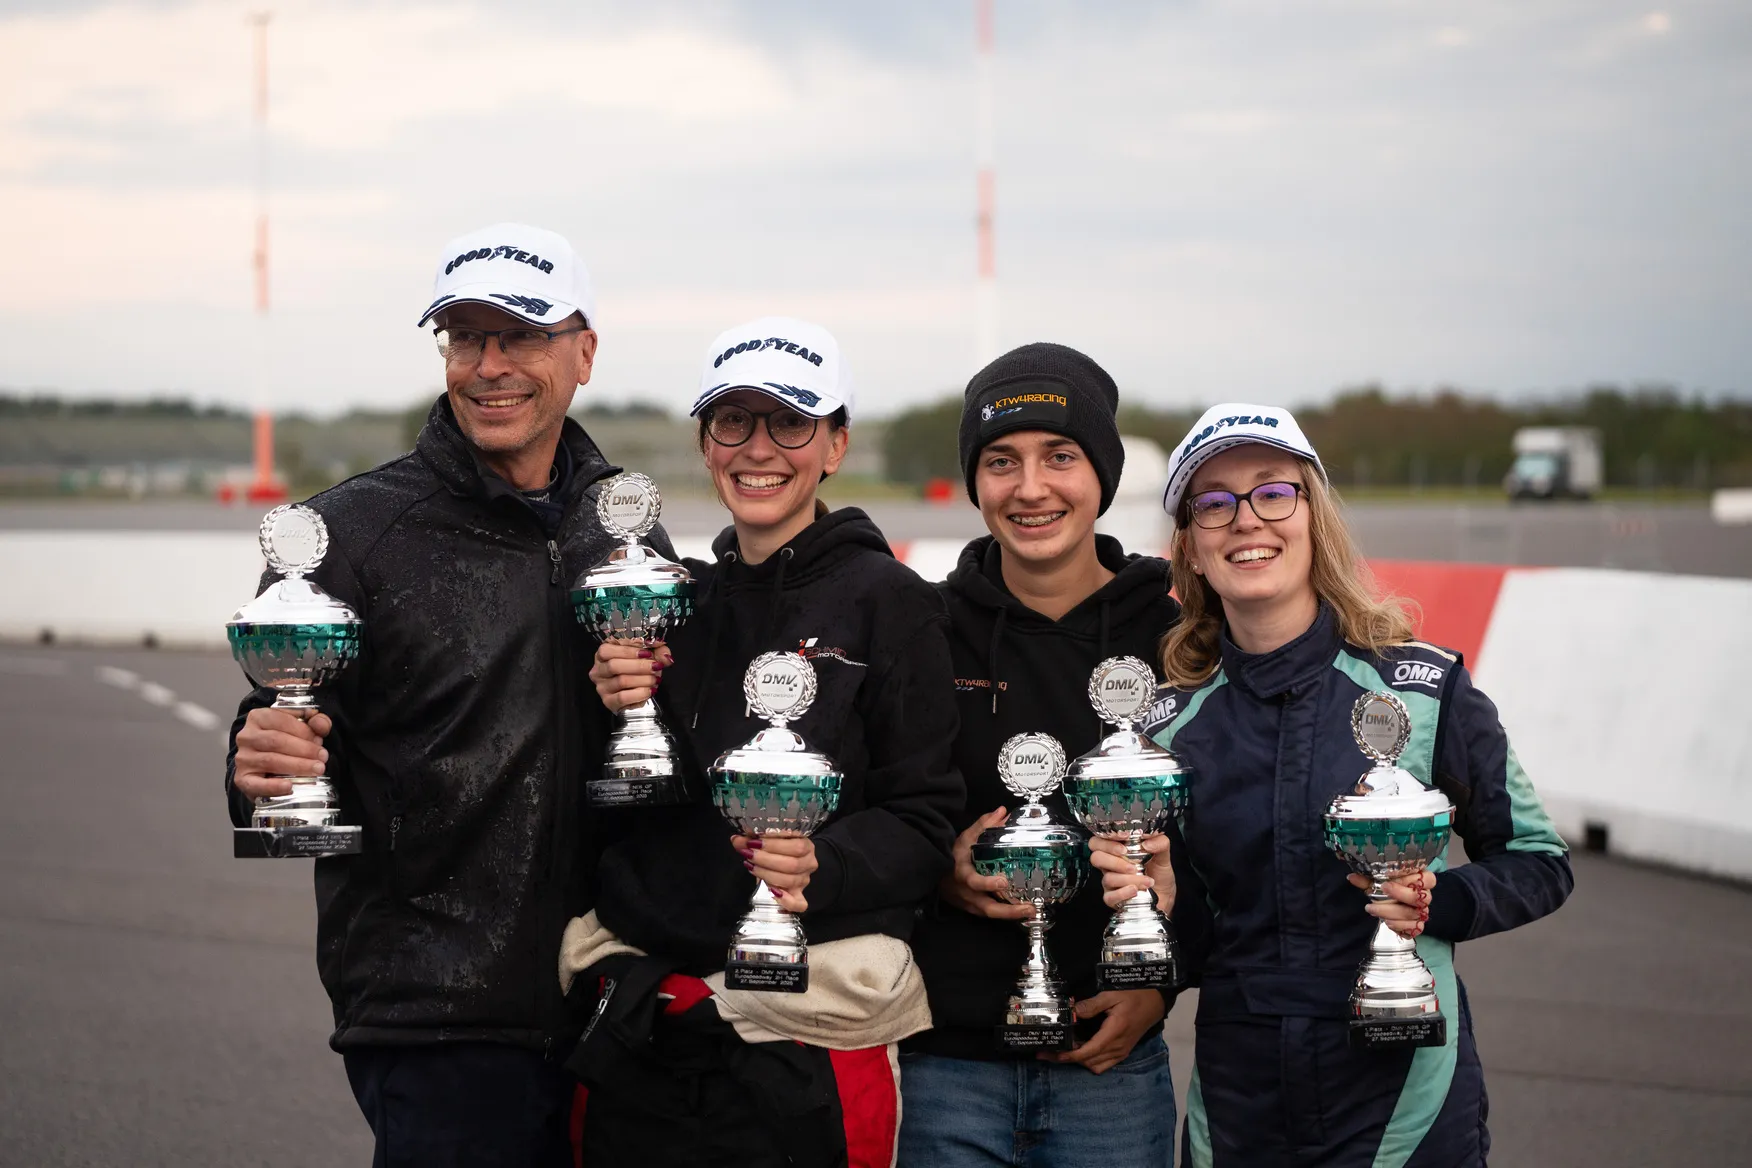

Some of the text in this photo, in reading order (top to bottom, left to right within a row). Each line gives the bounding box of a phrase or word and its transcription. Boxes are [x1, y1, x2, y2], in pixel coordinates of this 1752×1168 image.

[445, 246, 554, 275] GOODYEAR
[713, 338, 823, 368] GOODYEAR
[762, 673, 798, 685] DMV
[1394, 664, 1442, 682] OMP
[1105, 678, 1138, 690] DMV
[1014, 753, 1048, 764] DMV
